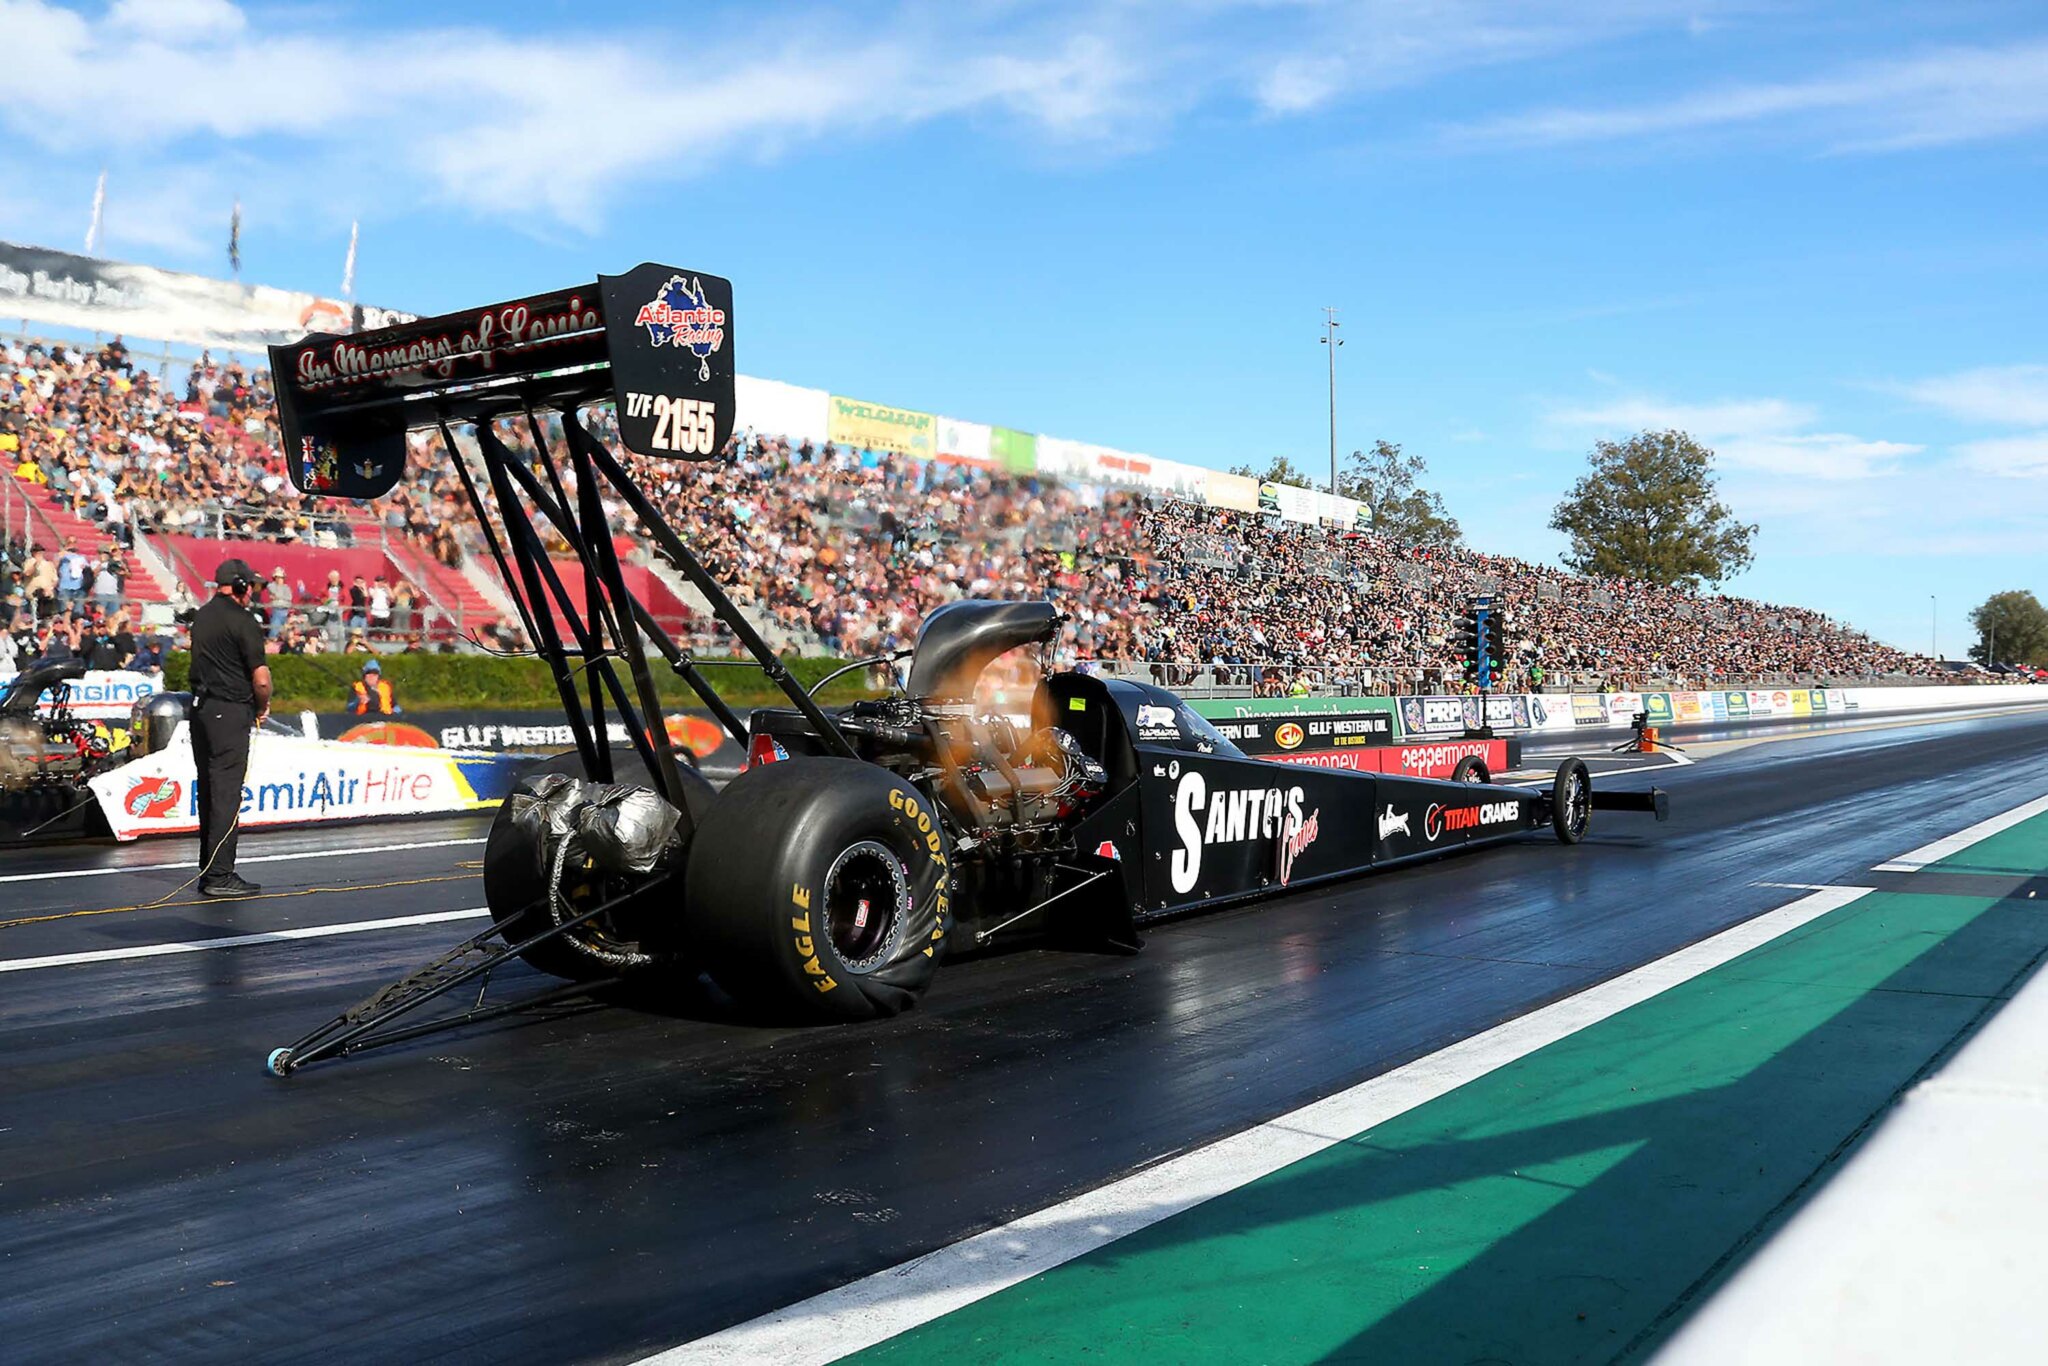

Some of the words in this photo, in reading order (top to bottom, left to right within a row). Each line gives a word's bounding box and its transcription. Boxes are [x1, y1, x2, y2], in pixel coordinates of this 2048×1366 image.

[634, 304, 725, 327] Atlantic
[298, 350, 334, 390] In
[333, 341, 454, 382] Memory
[461, 314, 495, 370] of
[500, 298, 600, 353] Louie
[672, 323, 725, 352] Racing
[626, 392, 653, 418] T/F
[651, 394, 716, 455] 2155
[1426, 701, 1461, 722] PRP
[441, 725, 498, 748] GULF
[501, 723, 598, 747] WESTER
[1244, 725, 1261, 738] OIL
[1309, 722, 1332, 735] GULF
[1333, 720, 1373, 734] WESTERN
[1374, 719, 1388, 732] OIL
[1444, 806, 1479, 831] TITAN
[1480, 801, 1519, 825] CRANES
[1170, 771, 1305, 894] SANTO'S
[792, 883, 838, 993] EAGLE
